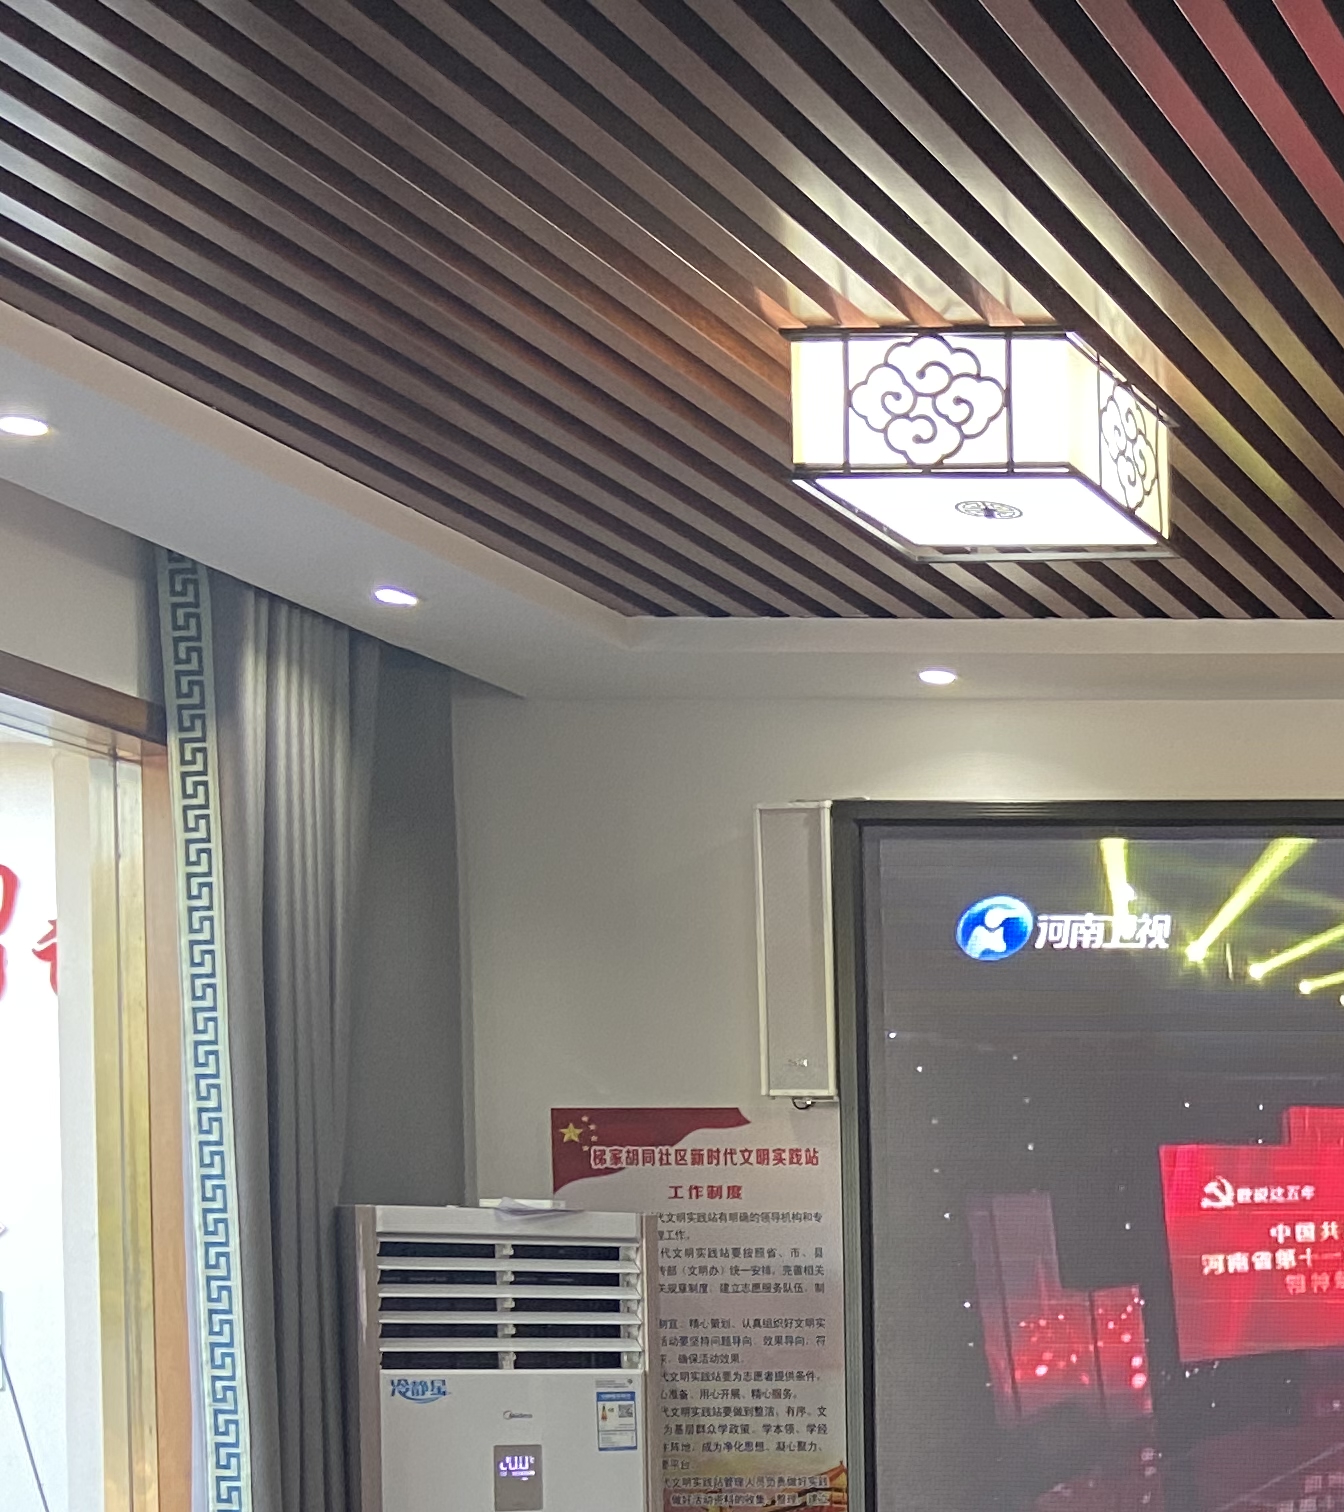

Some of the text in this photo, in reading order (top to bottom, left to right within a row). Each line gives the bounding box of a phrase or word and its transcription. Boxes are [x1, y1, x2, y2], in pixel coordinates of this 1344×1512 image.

[1034, 912, 1172, 950] 河南卫视
[668, 1184, 743, 1200] 工作制度
